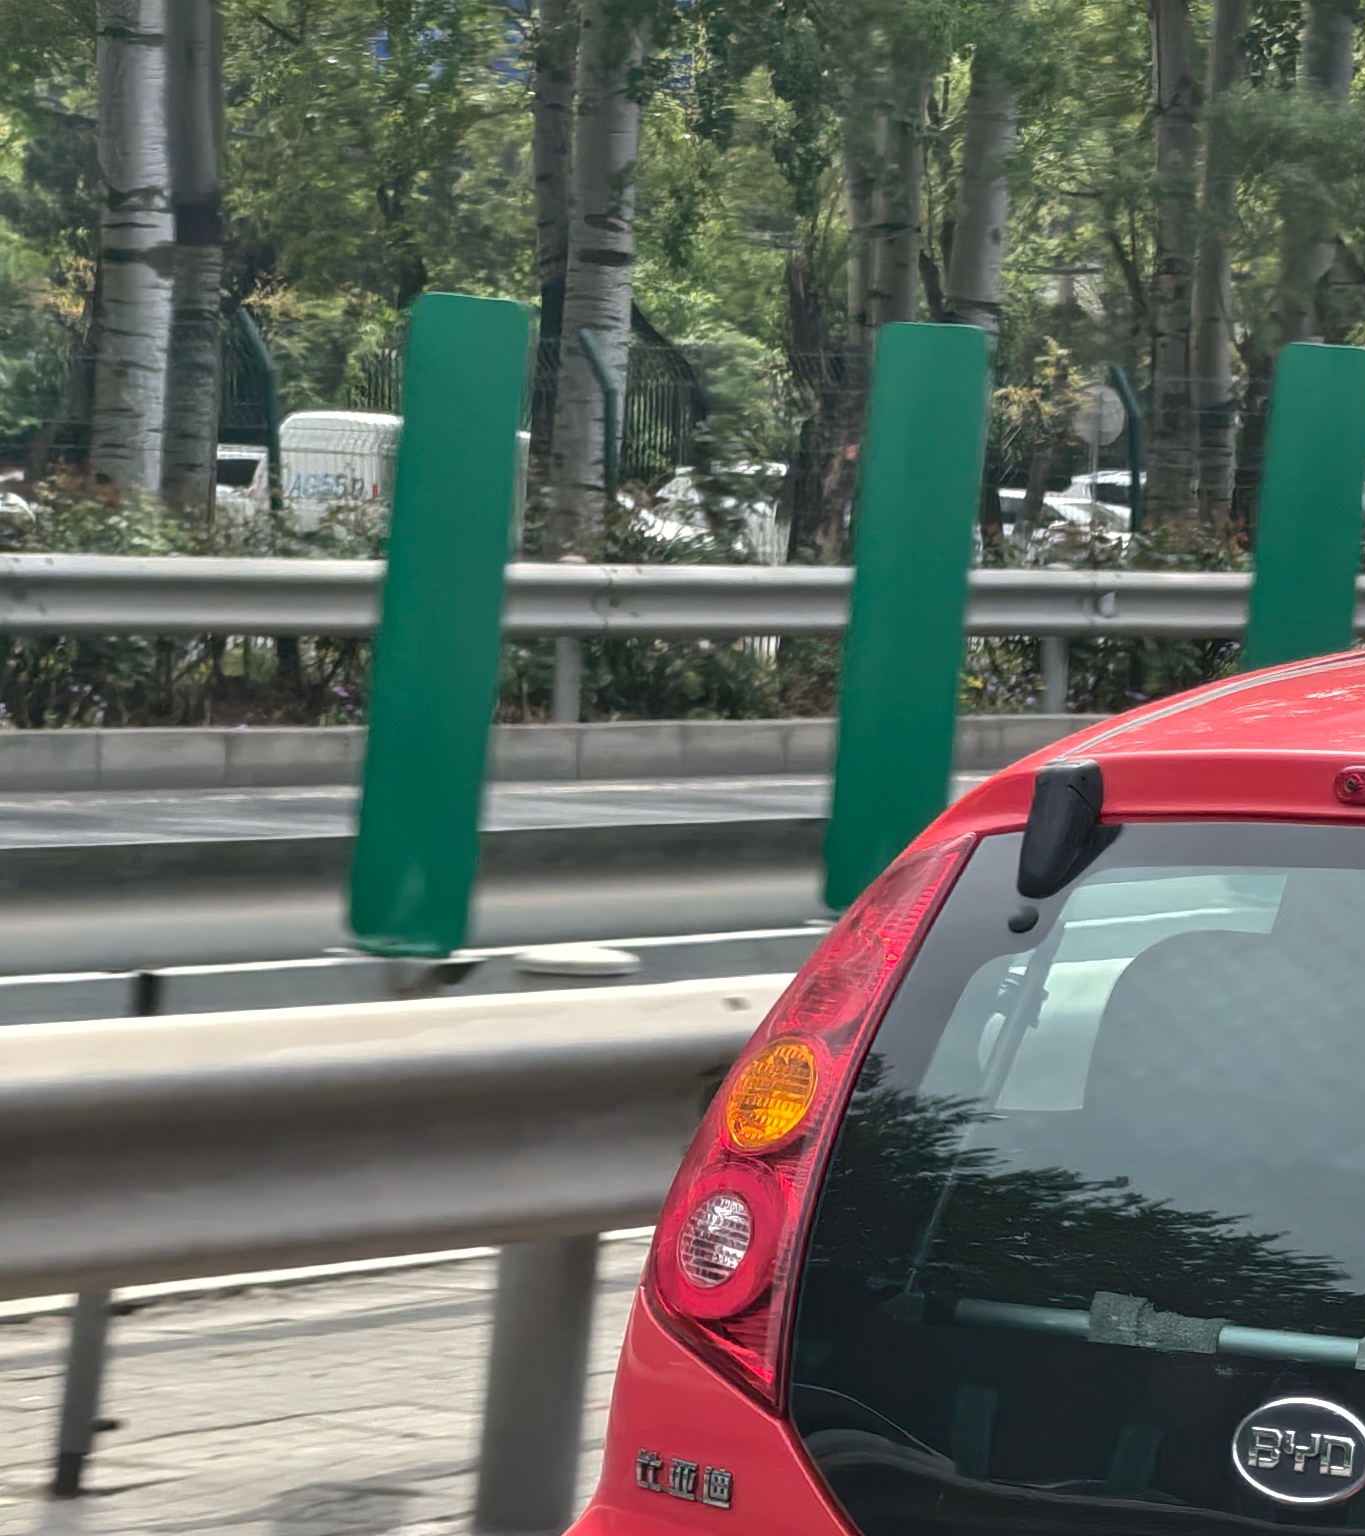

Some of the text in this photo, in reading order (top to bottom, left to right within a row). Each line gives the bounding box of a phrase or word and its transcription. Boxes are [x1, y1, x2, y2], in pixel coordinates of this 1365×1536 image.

[636, 1448, 733, 1509] 比亚迪
[1248, 1426, 1355, 1477] BYD
